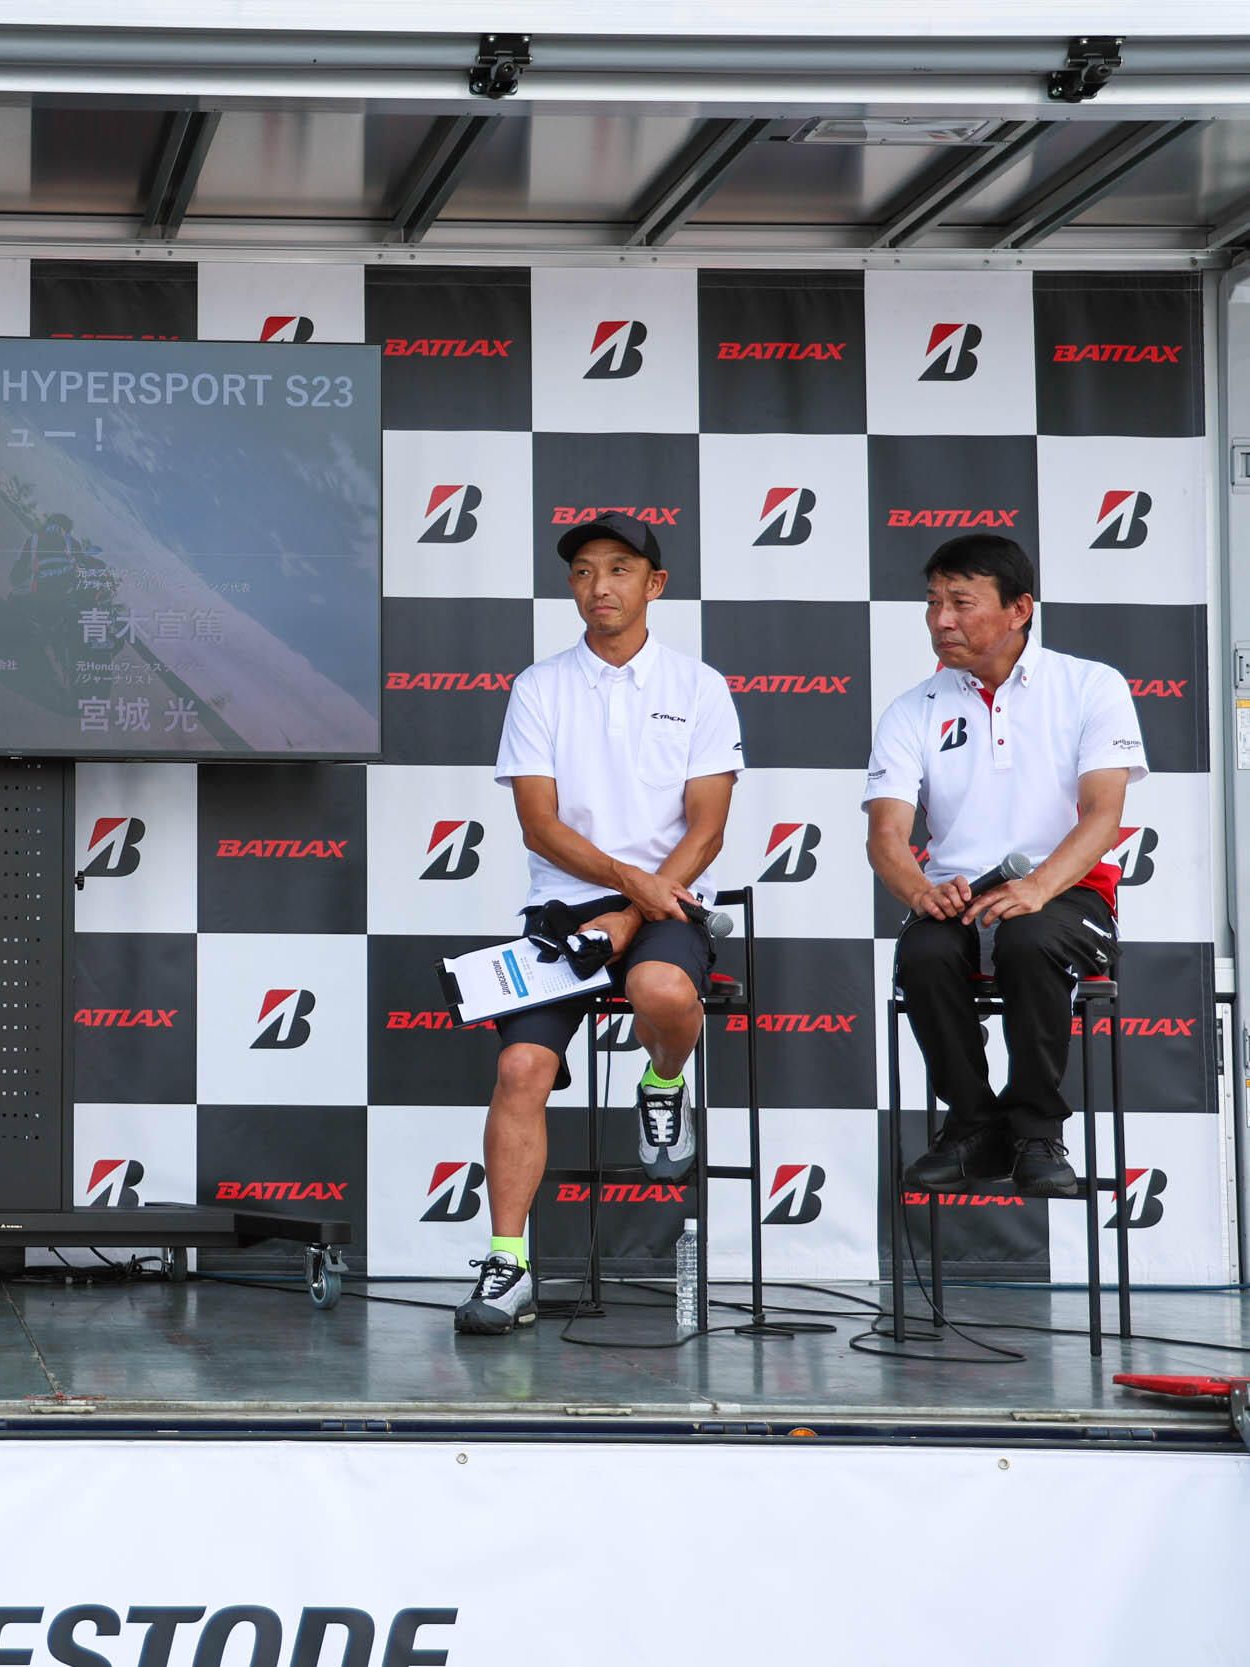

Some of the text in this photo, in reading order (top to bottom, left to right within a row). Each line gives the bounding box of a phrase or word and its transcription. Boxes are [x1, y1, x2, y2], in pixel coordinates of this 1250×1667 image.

[384, 337, 512, 358] BATTLAX
[718, 341, 846, 361] BATTLAX
[1054, 344, 1183, 364] BATTLAX
[2, 369, 272, 407] HYPERSPORT
[285, 374, 354, 408] S23
[888, 509, 1019, 528] BATTLAX
[386, 671, 515, 691] BATTLAX
[78, 696, 199, 733] 宮城 光
[216, 839, 348, 859] BATTLAX
[74, 1008, 179, 1028] ATTLAX
[215, 1181, 348, 1201] BATTLAX
